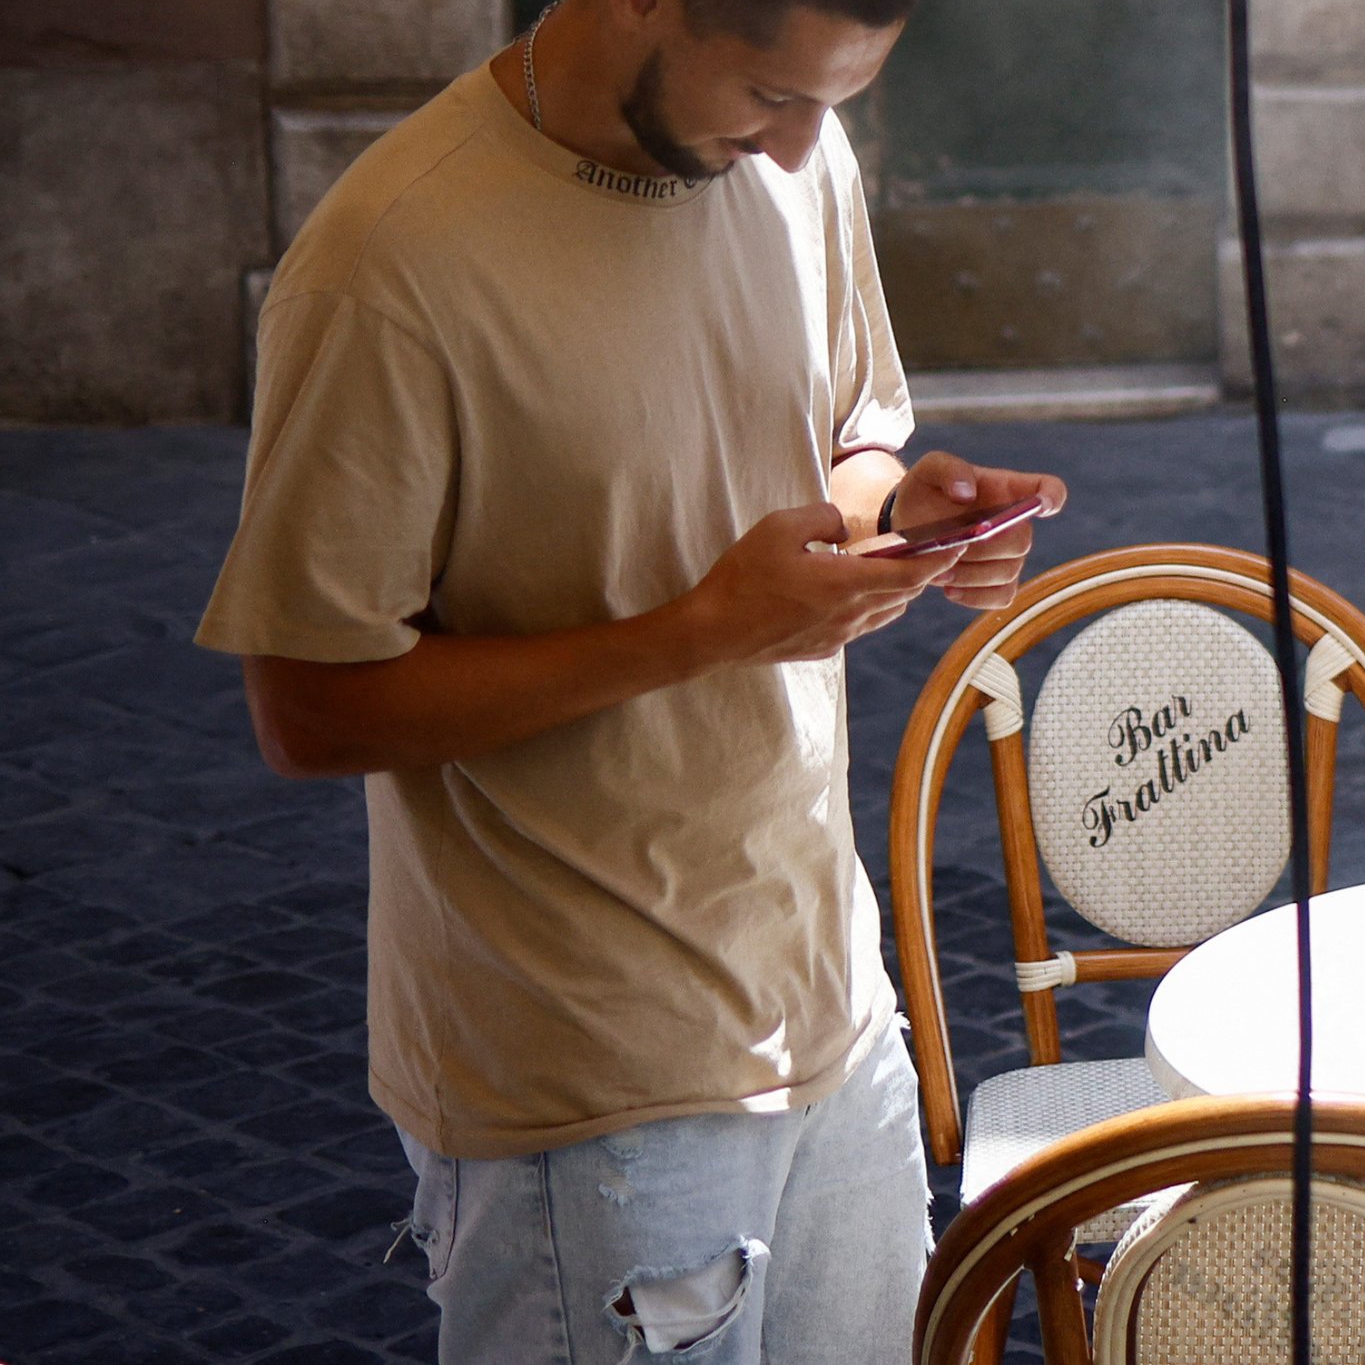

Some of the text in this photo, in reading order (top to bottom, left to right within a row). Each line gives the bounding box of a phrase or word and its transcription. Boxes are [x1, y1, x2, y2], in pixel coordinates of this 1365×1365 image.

[573, 159, 678, 200] Another
[1107, 694, 1192, 767] Bar
[1081, 708, 1251, 848] Frattina
